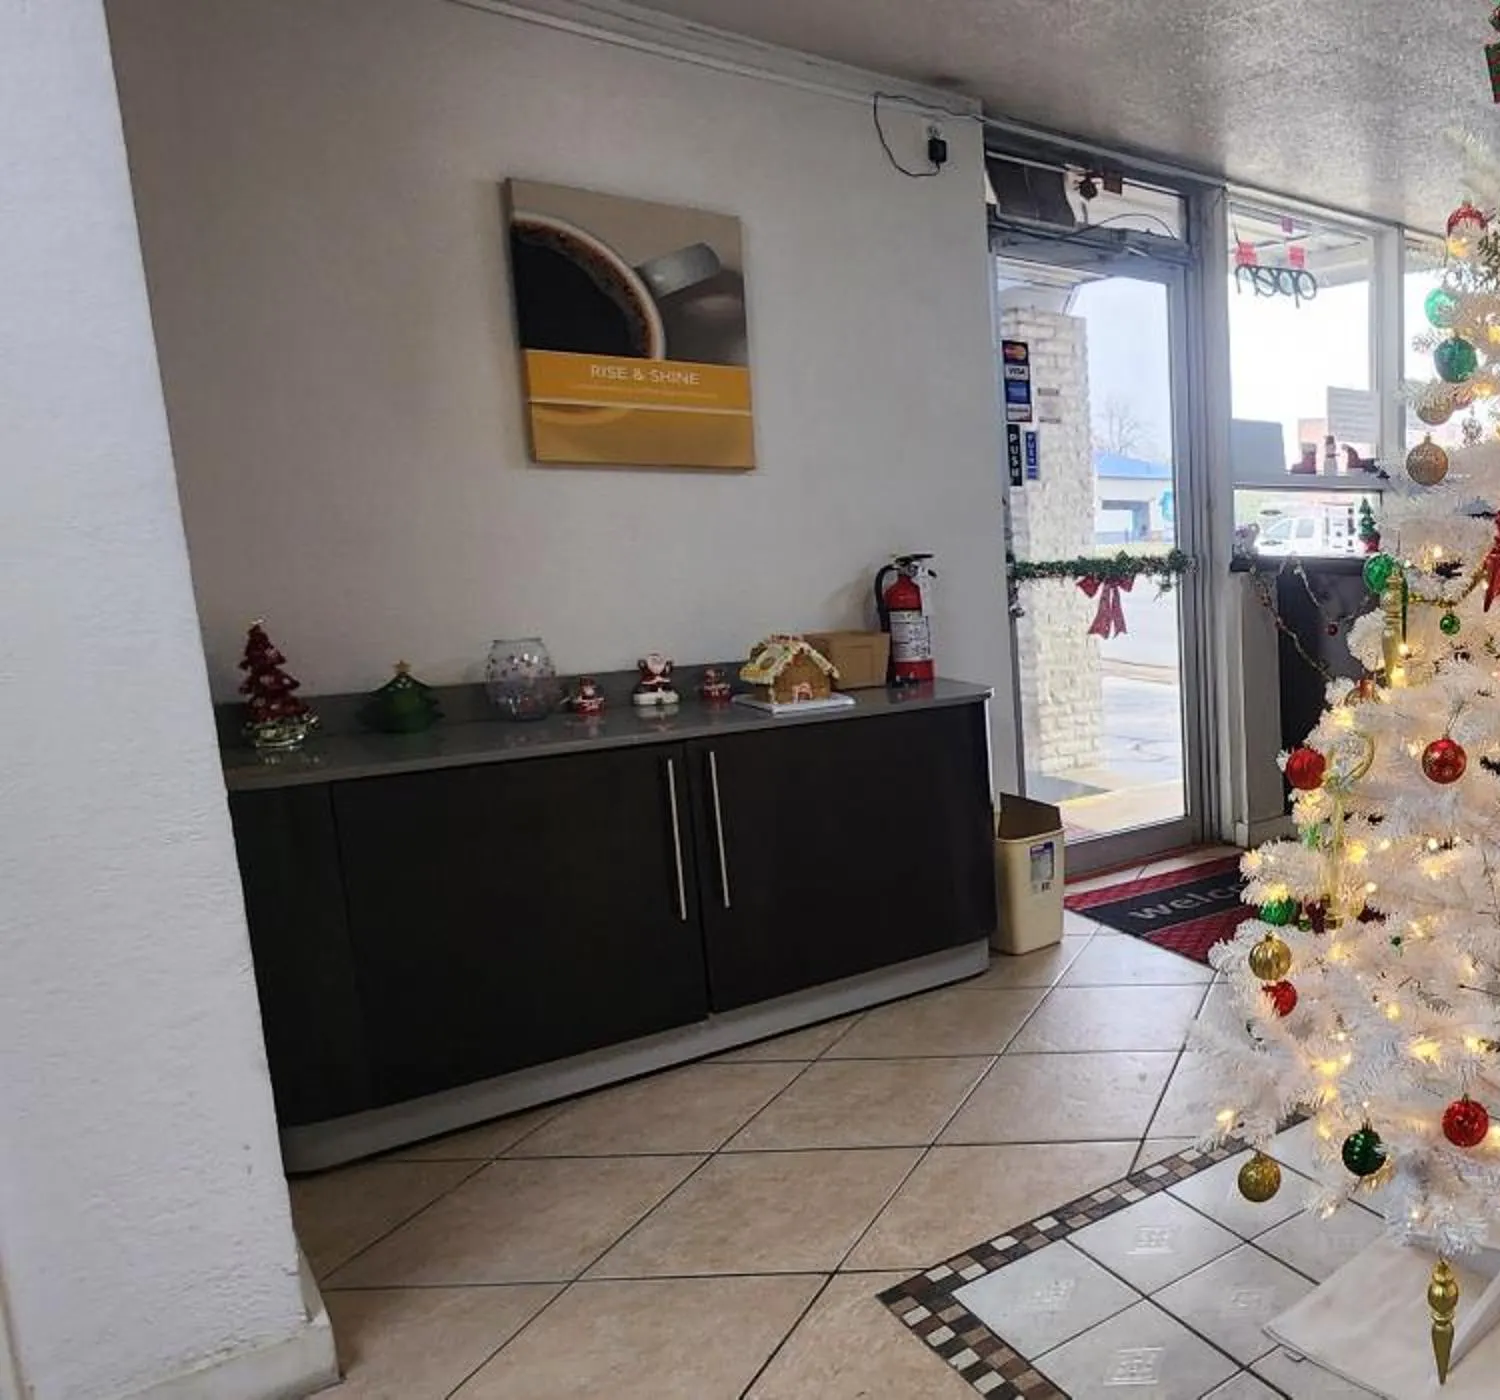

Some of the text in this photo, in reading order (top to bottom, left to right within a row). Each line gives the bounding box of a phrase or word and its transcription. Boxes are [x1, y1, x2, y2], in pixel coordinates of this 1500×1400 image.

[590, 363, 701, 386] RISE & SHINE
[1008, 366, 1026, 376] VISA
[1009, 432, 1020, 478] PUSH
